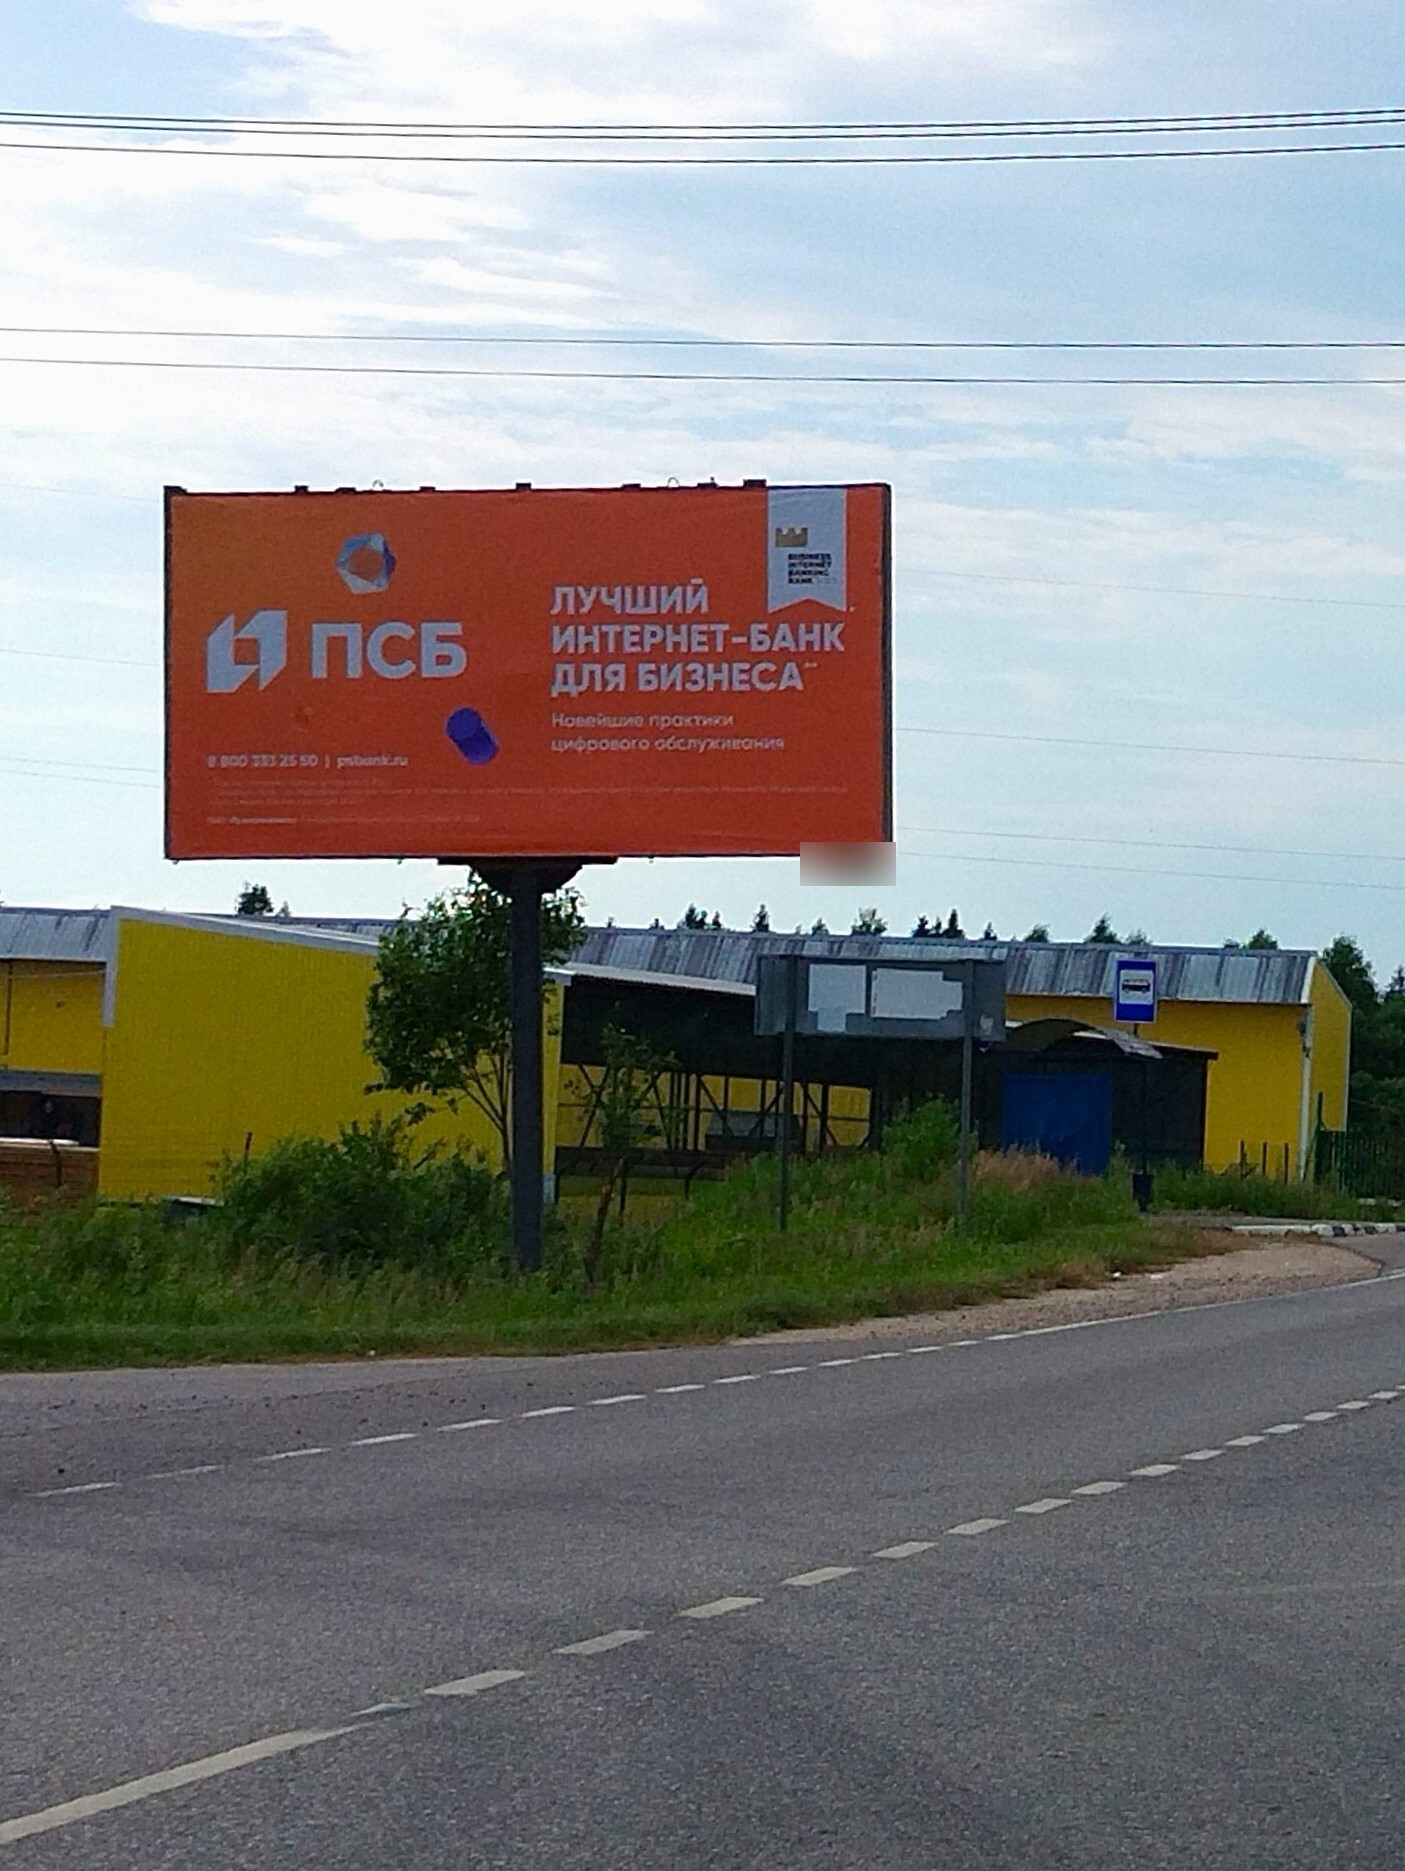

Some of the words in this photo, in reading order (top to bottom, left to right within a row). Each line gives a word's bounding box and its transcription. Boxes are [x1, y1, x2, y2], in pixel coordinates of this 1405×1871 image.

[550, 578, 709, 615] ЛУЧШИЙ
[311, 621, 468, 680] ПСБ
[551, 621, 845, 654] ИНТЕРНЕТ-БАНК
[550, 662, 627, 698] ДЛЯ
[551, 711, 644, 728] Новейшие
[649, 714, 734, 730] практики
[551, 736, 650, 753] цифрового
[654, 734, 785, 753] обслуживания
